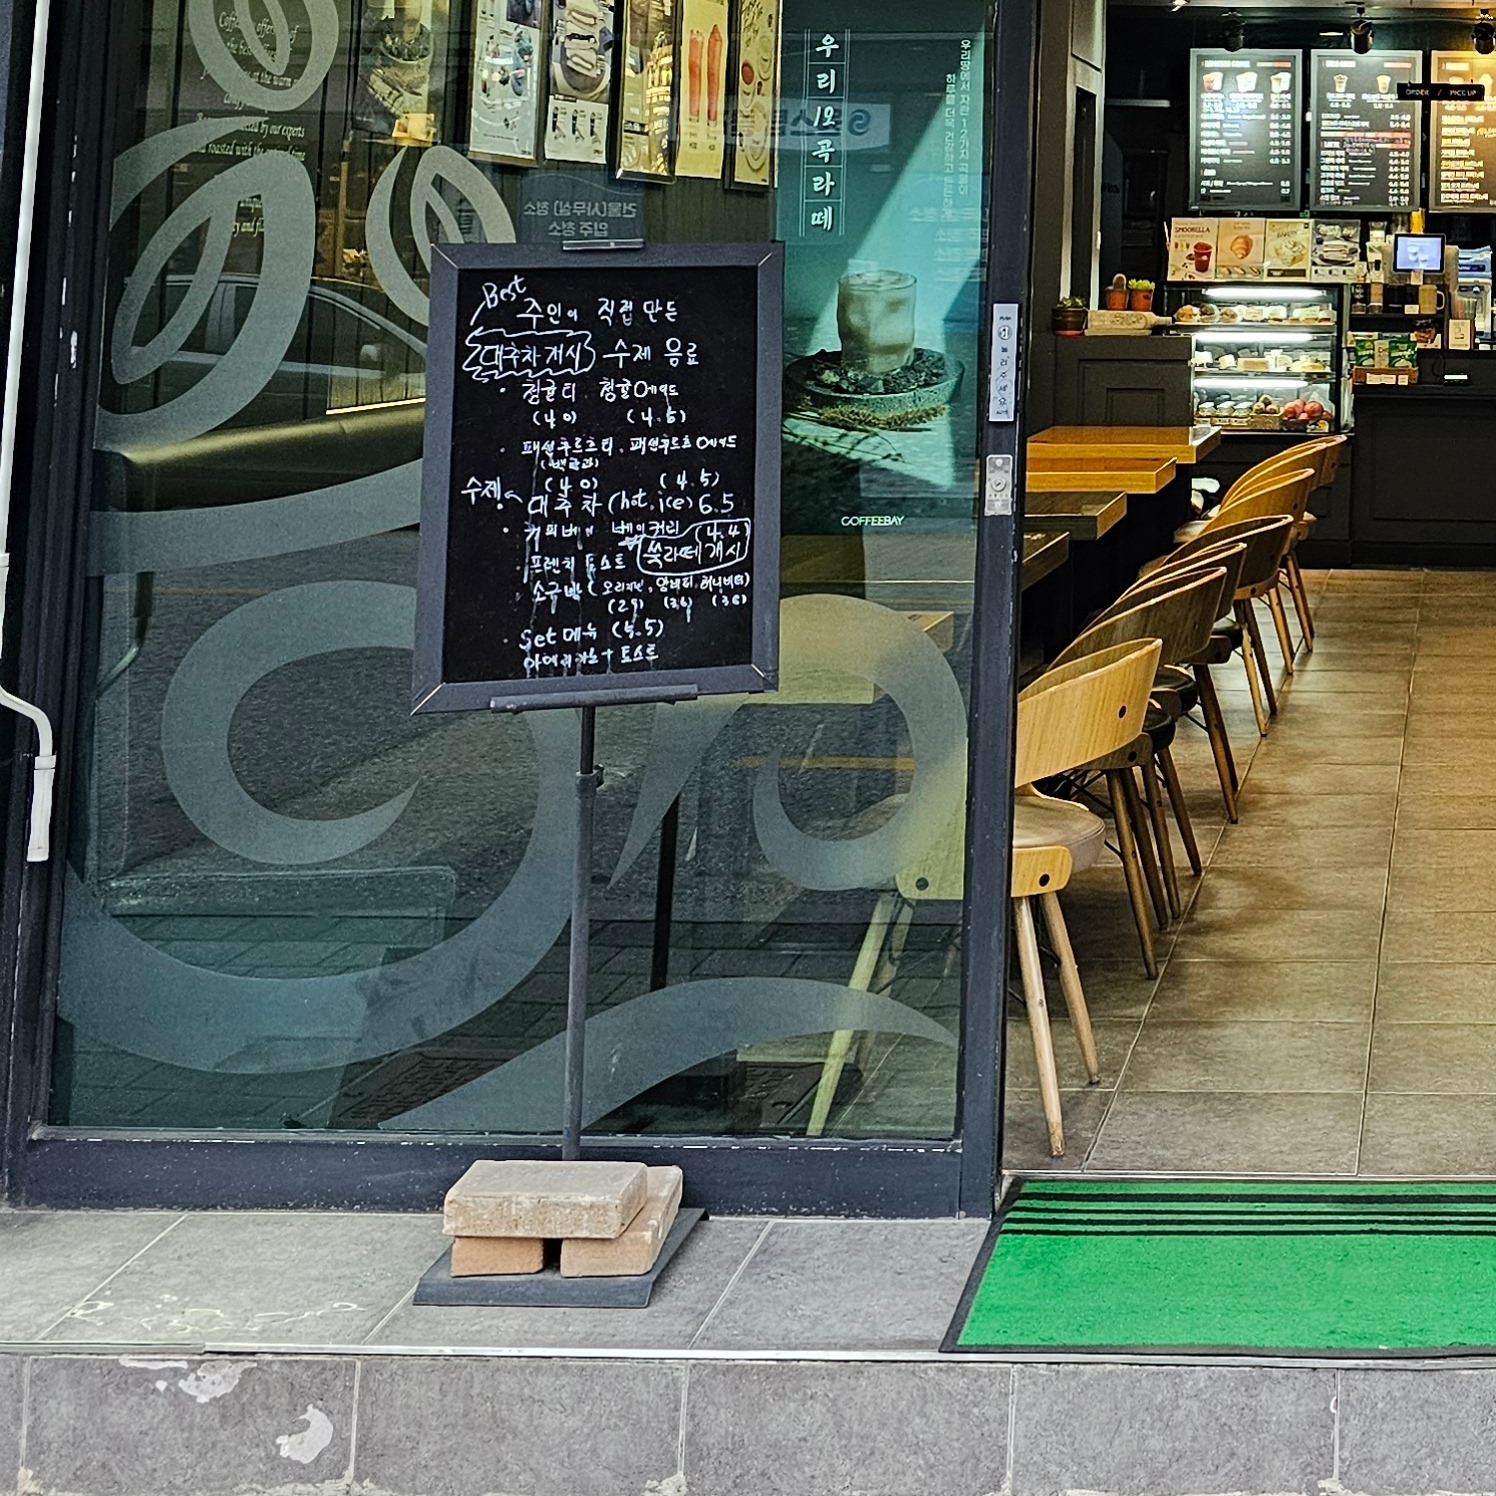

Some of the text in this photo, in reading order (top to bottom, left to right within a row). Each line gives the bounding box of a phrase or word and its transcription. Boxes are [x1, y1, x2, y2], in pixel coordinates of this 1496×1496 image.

[482, 274, 528, 309] Best
[516, 297, 678, 330] 주인이 직접 만든
[479, 341, 541, 372] 대추차
[602, 336, 700, 369] 수제 음료
[698, 493, 735, 516] 6.5
[841, 515, 905, 527] COFFEEBAY
[530, 554, 576, 574] 프렌치
[518, 625, 557, 651] Set
[562, 621, 598, 642] 메뉴
[620, 642, 659, 664] 토스트
